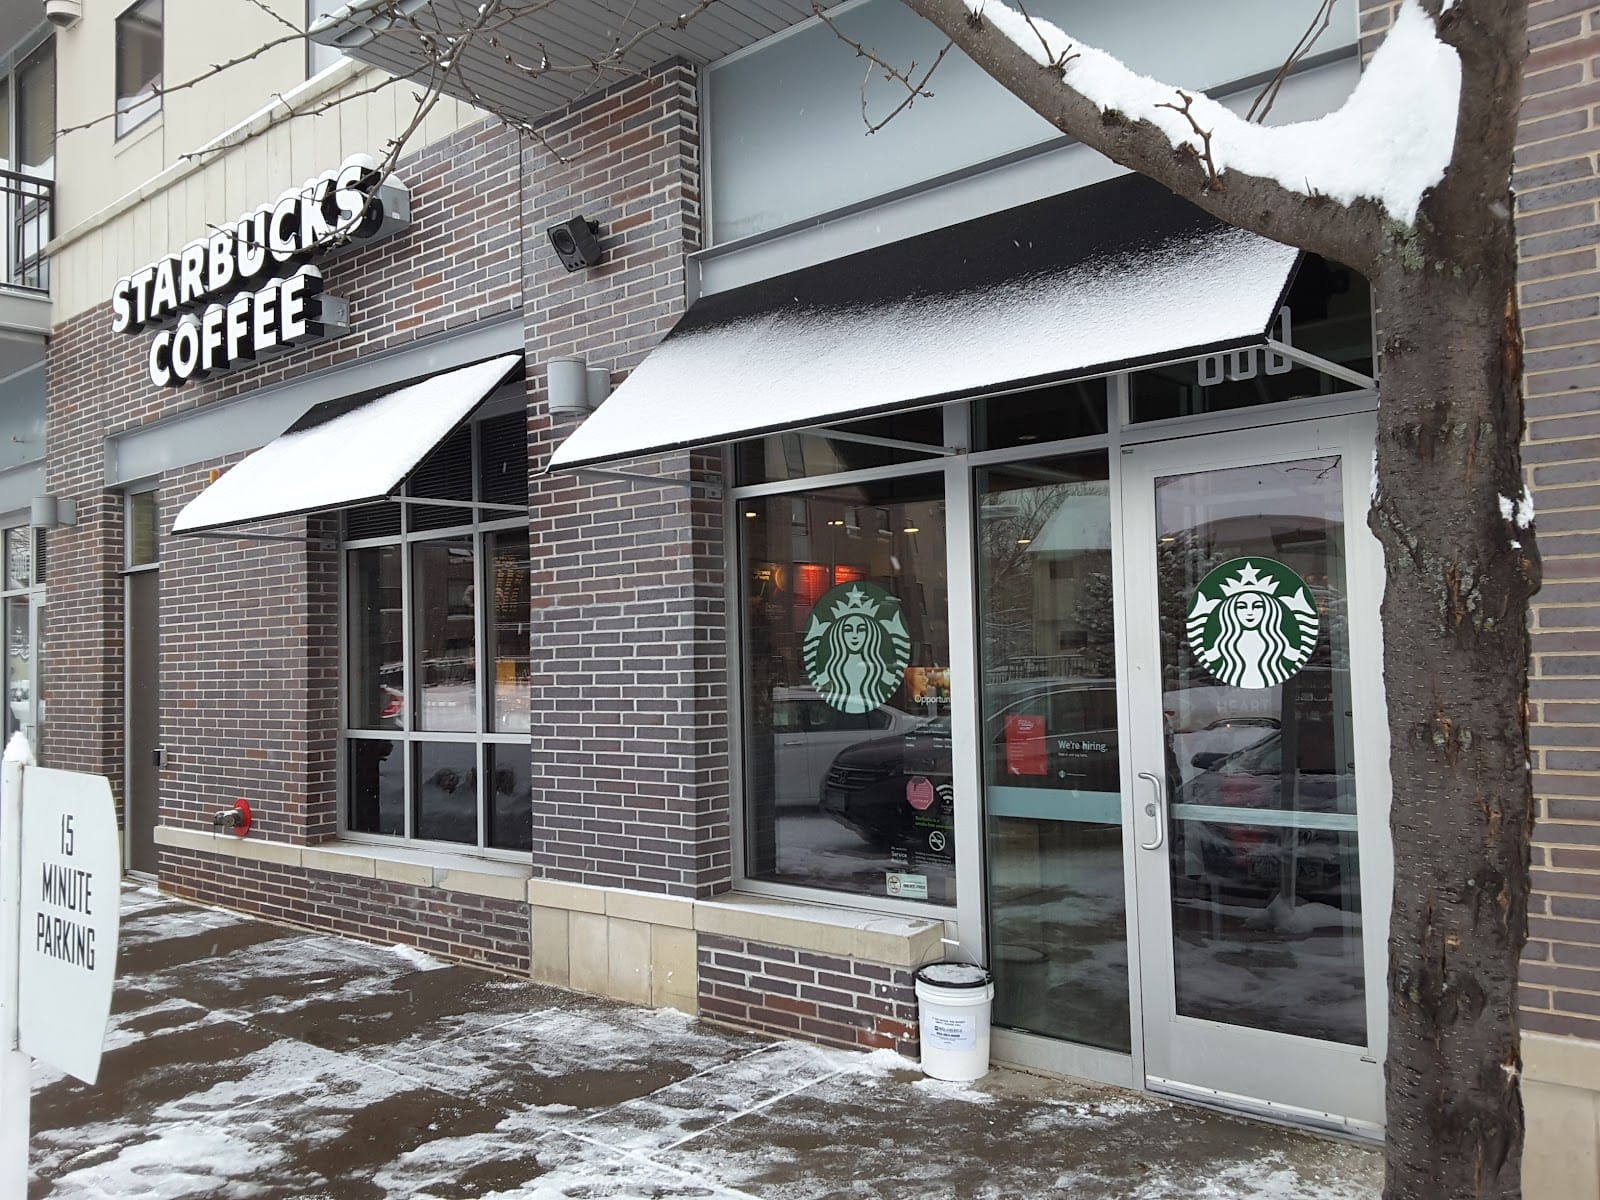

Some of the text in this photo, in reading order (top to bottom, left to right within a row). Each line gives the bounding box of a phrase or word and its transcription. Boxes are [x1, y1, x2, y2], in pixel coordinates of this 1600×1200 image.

[112, 166, 365, 333] STARBUCKS
[149, 274, 306, 387] COFFEE
[1058, 740, 1080, 750] We're
[60, 813, 74, 856] 15
[42, 861, 92, 915] MINUTE
[36, 911, 95, 971] PARKING
